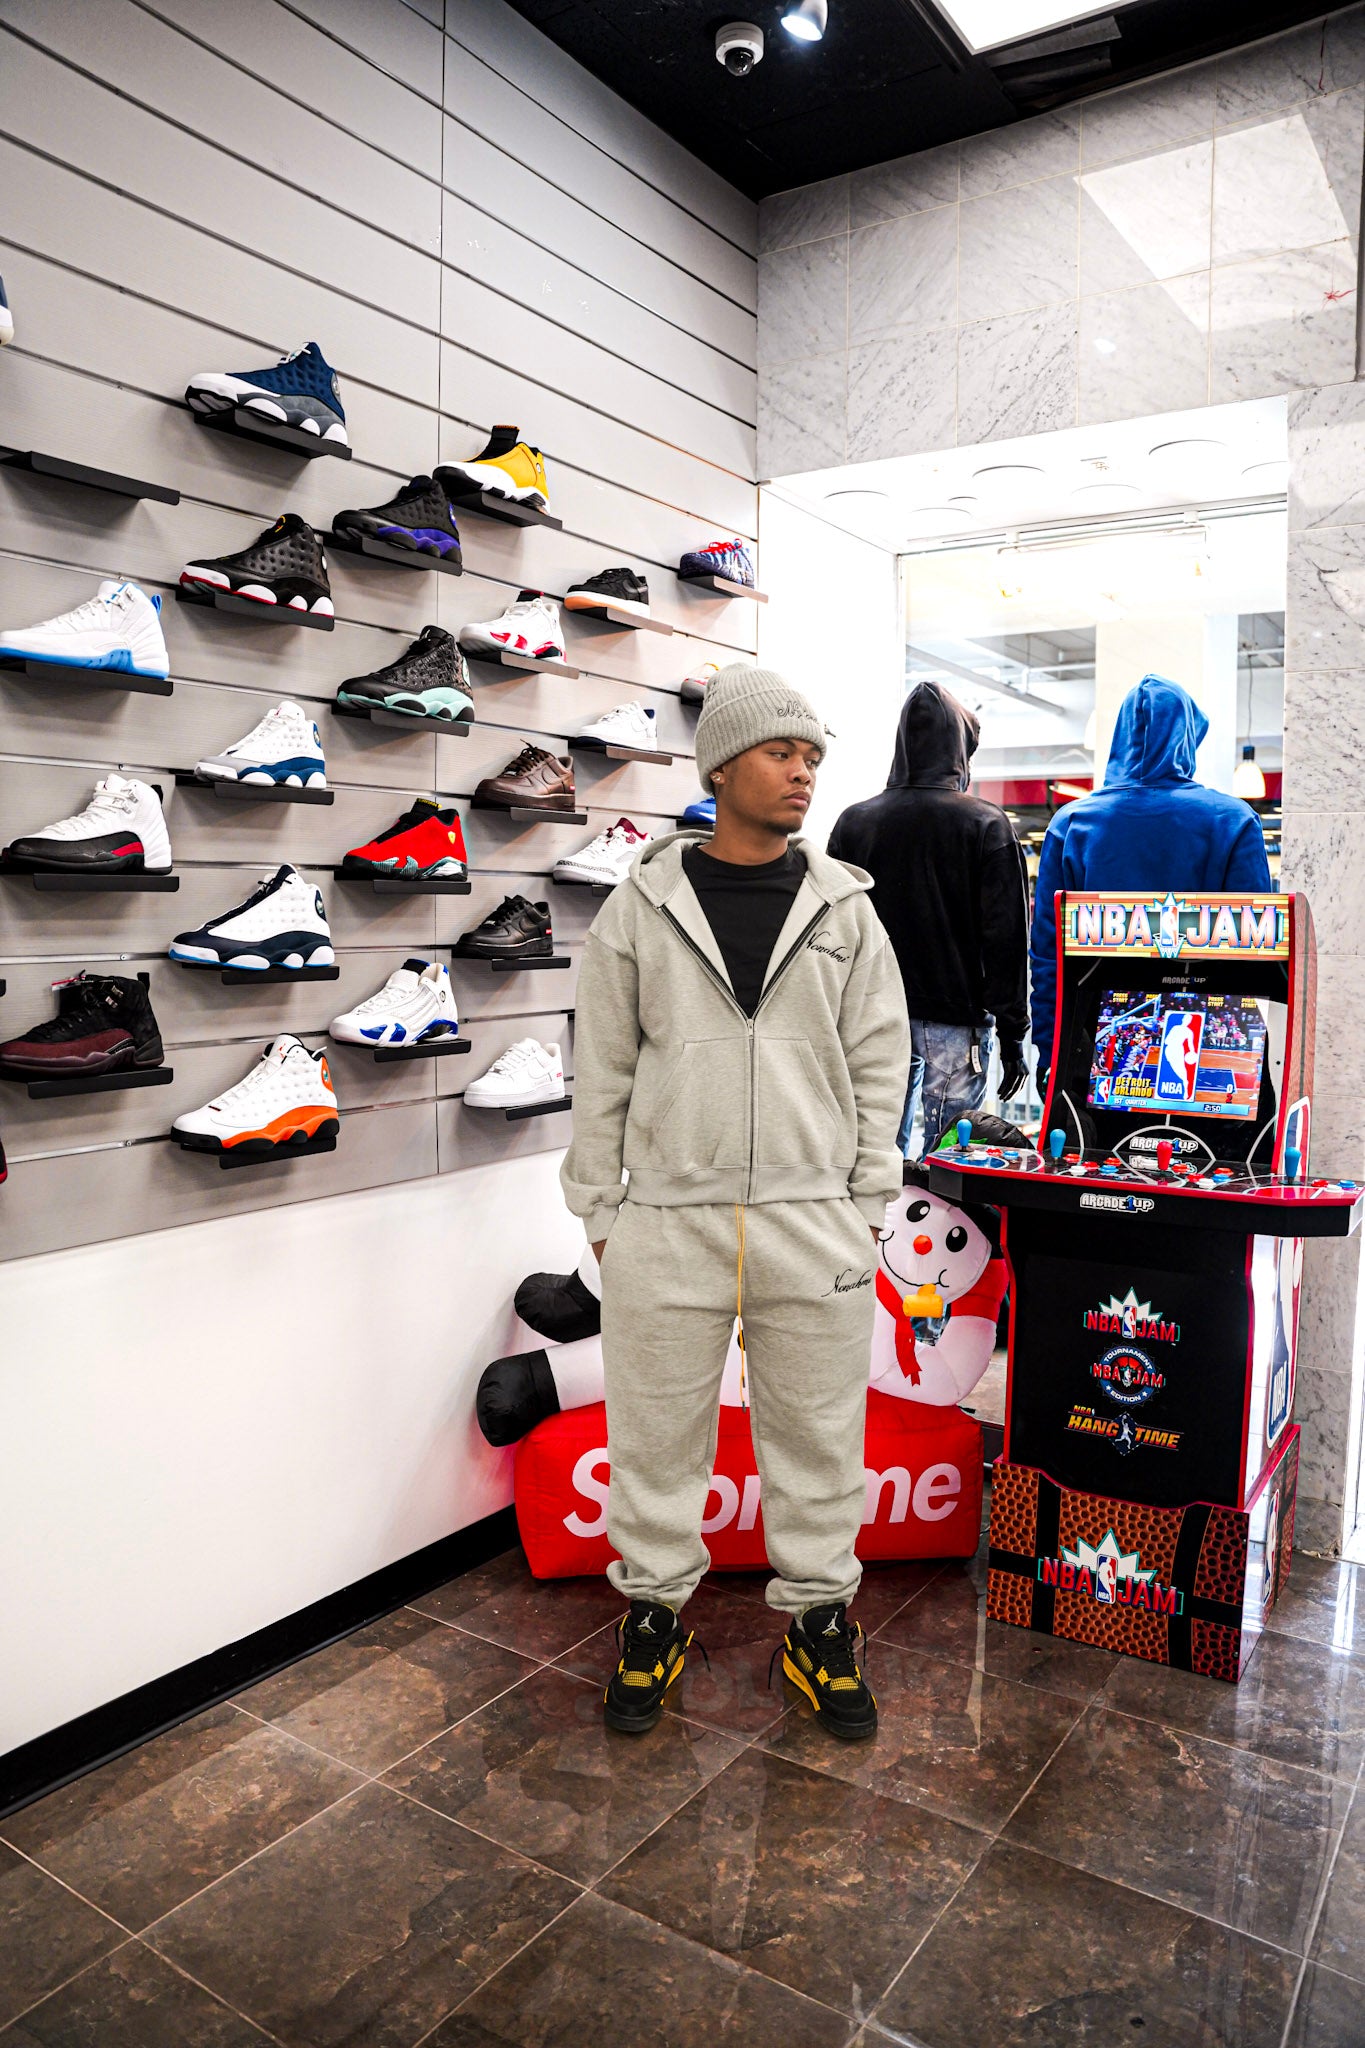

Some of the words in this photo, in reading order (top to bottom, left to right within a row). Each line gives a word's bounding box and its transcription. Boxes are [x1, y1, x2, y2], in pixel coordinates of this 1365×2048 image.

[1077, 904, 1154, 947] NBA
[1186, 905, 1278, 949] JAM
[1115, 1077, 1151, 1088] DETROIT
[1161, 1082, 1183, 1095] NBA
[1114, 1086, 1153, 1097] ORLANDO
[1204, 1104, 1221, 1112] 2:50
[1087, 1310, 1121, 1334] NBA
[1136, 1318, 1176, 1343] JAM
[1104, 1348, 1153, 1370] TOURNAMENT
[1093, 1363, 1121, 1382] NBA
[1132, 1370, 1163, 1388] JAM
[1110, 1390, 1142, 1403] EDITION
[1073, 1405, 1092, 1415] NBA
[1067, 1414, 1119, 1438] HANG
[1134, 1427, 1181, 1449] TIME
[1042, 1557, 1094, 1596] NBA
[1117, 1575, 1178, 1616] JAM
